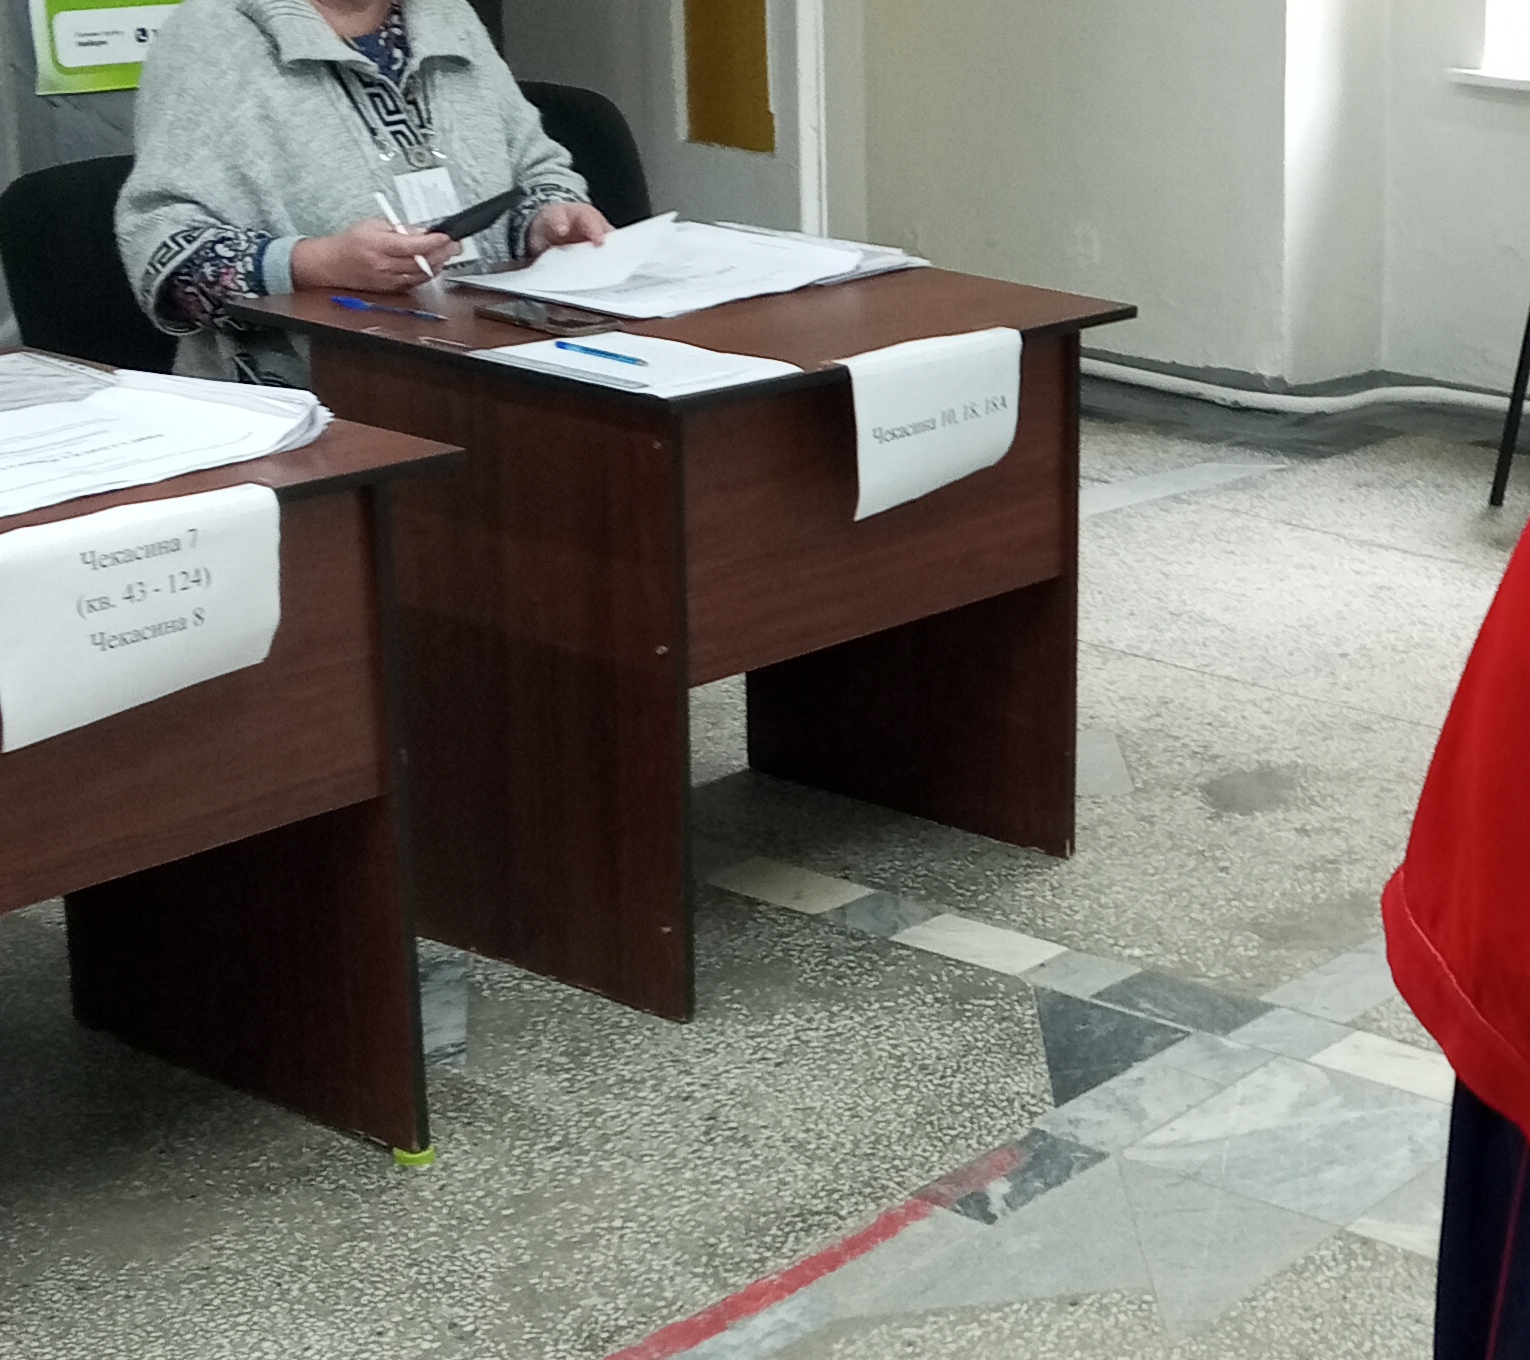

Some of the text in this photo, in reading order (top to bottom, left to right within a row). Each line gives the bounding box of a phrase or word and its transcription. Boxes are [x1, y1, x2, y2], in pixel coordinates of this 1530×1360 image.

[79, 528, 199, 571] Чекасина 7
[76, 594, 117, 620] (кв.
[122, 582, 147, 603] 43
[168, 566, 213, 594] 124)
[90, 607, 206, 651] Чекасина 8
